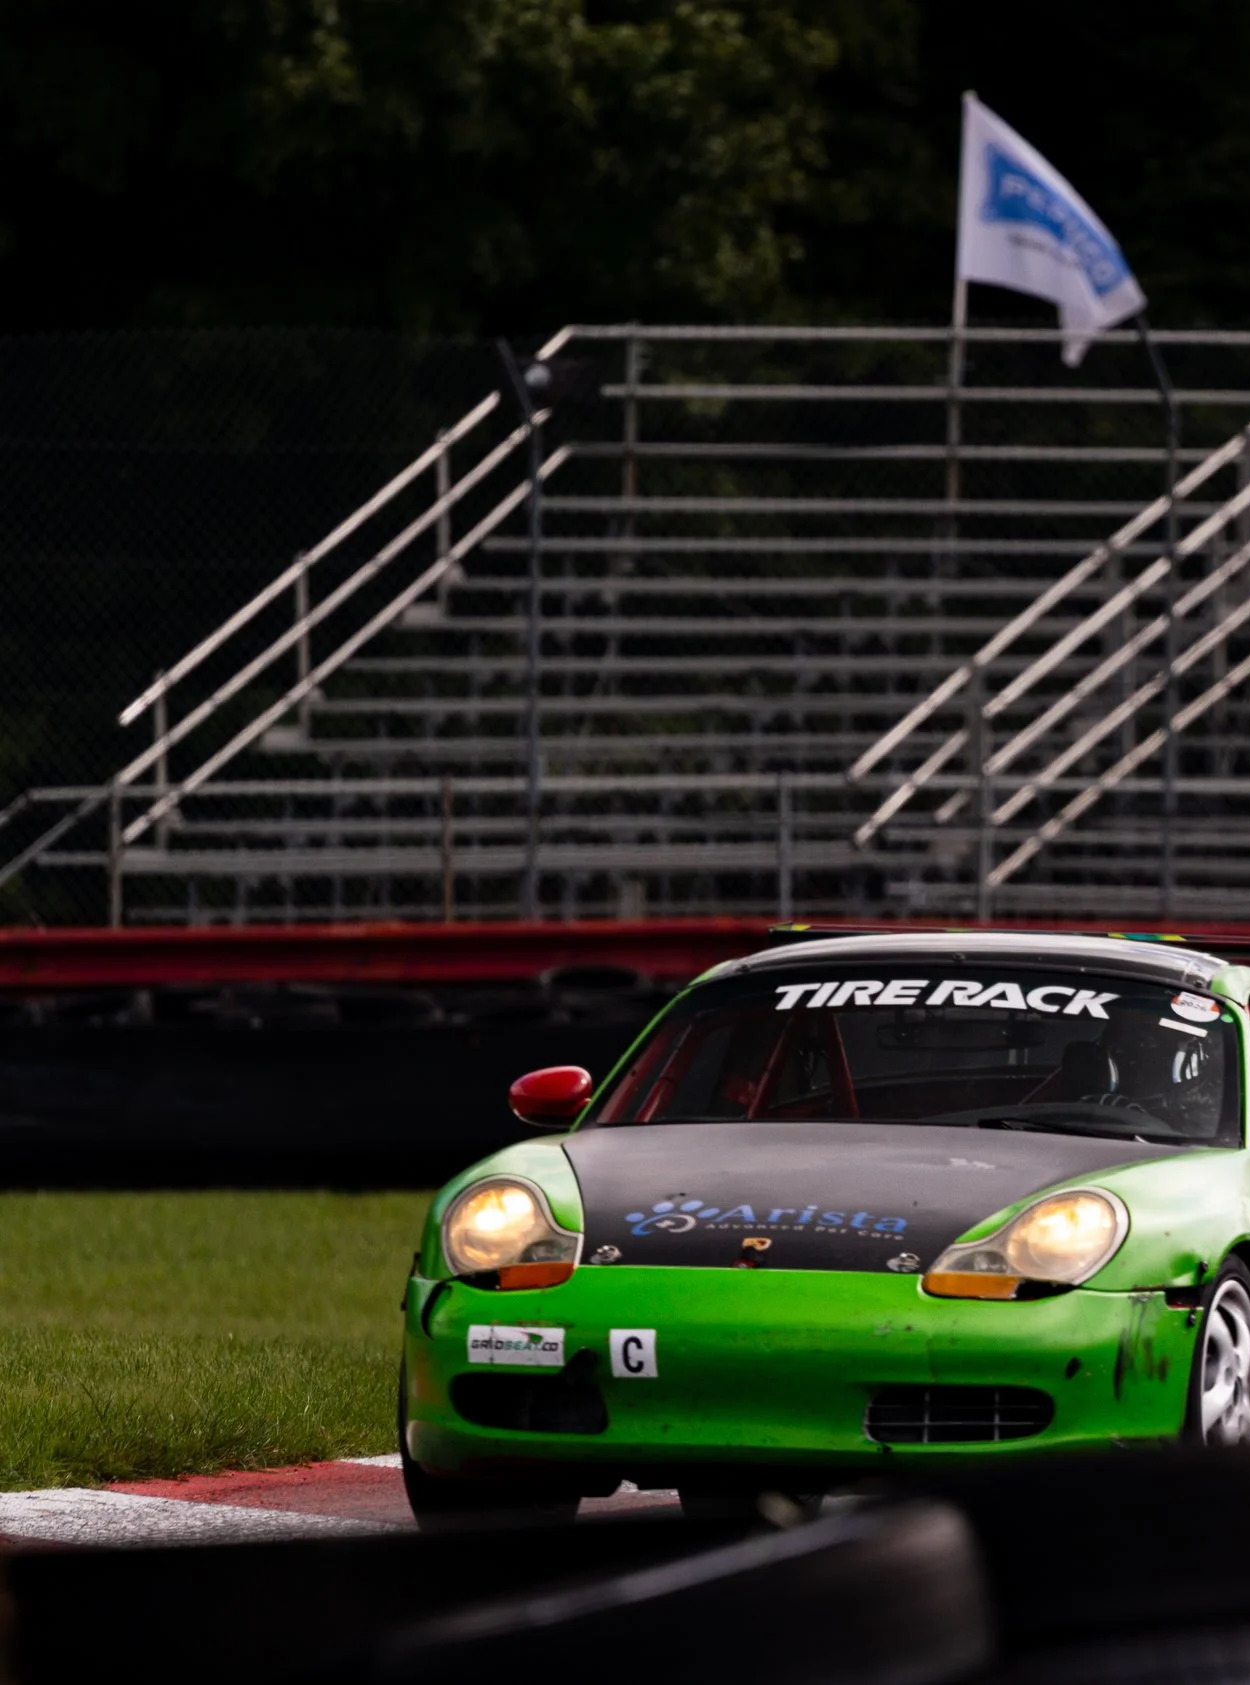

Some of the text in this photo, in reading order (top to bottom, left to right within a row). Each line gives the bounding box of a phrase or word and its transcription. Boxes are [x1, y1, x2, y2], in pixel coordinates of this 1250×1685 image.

[774, 979, 1120, 1019] TIRE RACK
[714, 1203, 909, 1234] Arista
[621, 1336, 645, 1374] C
